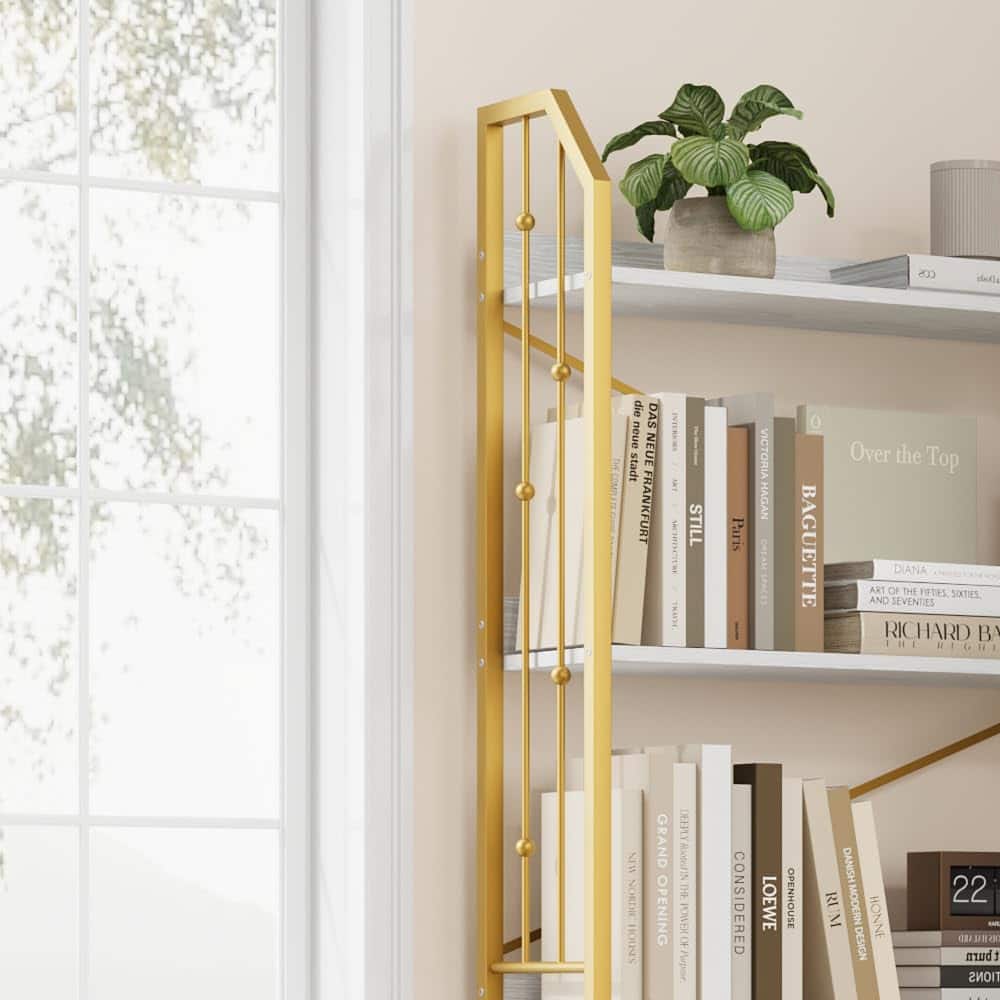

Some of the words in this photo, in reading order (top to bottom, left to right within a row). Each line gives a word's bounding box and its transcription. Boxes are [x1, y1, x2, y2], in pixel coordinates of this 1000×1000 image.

[633, 400, 644, 417] die
[646, 403, 658, 429] DAS
[631, 421, 640, 449] neue
[643, 433, 656, 467] NEUE
[629, 452, 641, 482] stadt
[760, 428, 769, 479] VICTORIA
[850, 440, 891, 465] Over
[896, 443, 922, 465] the
[926, 446, 960, 475] Top
[639, 470, 653, 544] FRANKFURT
[760, 482, 769, 520] HAGAN
[689, 504, 703, 546] STILL
[732, 517, 745, 552] Paris
[801, 484, 818, 607] BAGUETTE
[894, 564, 927, 576] DIANA
[870, 586, 886, 597] ART
[889, 587, 901, 597] OF
[903, 588, 919, 598] THE
[952, 590, 983, 601] SIXTIES,
[870, 596, 889, 606] AND
[891, 597, 935, 607] SEVENTIES
[885, 621, 971, 642] RICHARD
[656, 814, 669, 868] GRAND
[679, 809, 690, 841] DEEPLY
[627, 852, 637, 874] NEW
[842, 848, 856, 882] DANISH
[627, 879, 637, 919] NORDIC
[680, 883, 690, 900] THE
[734, 851, 745, 956] CONSIDERED
[762, 876, 777, 931] LOEWE
[786, 868, 796, 928] OPENHOUSE
[846, 884, 861, 925] MODERN
[953, 875, 988, 904] 22
[656, 874, 669, 946] OPENING
[680, 903, 690, 933] POWER
[825, 891, 842, 929] RUM
[869, 896, 885, 939] HONNE
[627, 924, 637, 965] HOUSES
[680, 937, 690, 949] OF
[854, 927, 867, 960] DESIGN
